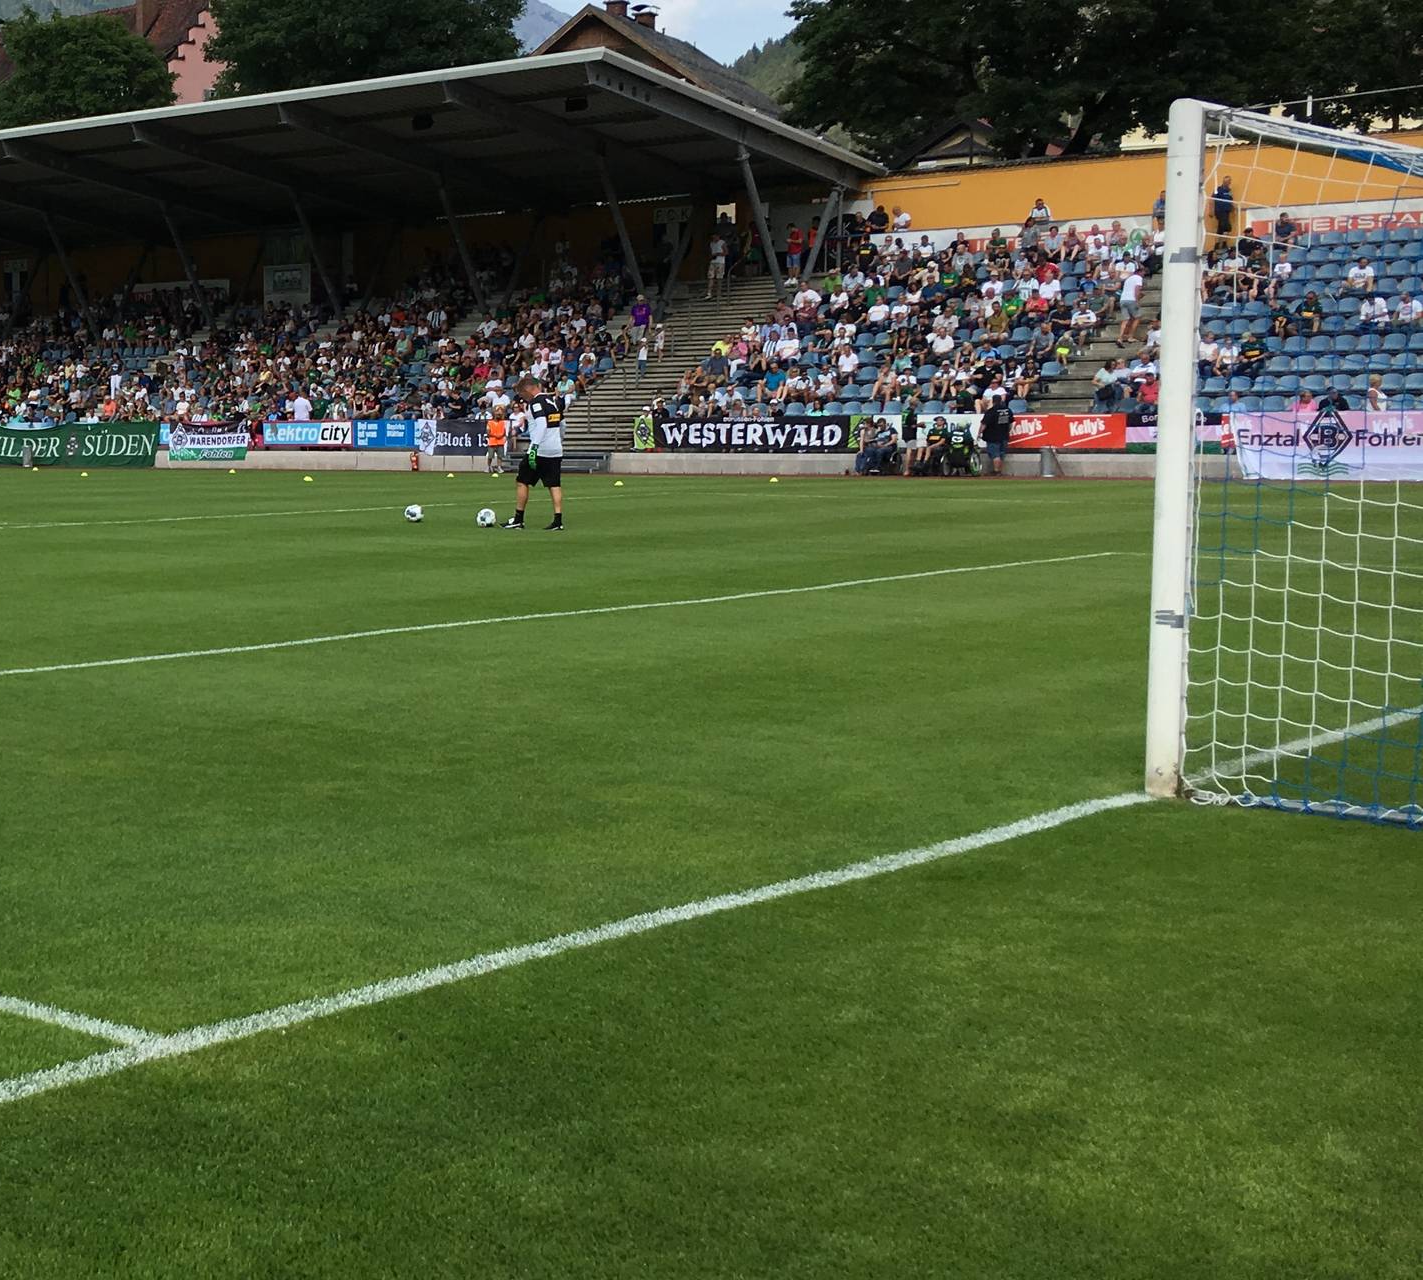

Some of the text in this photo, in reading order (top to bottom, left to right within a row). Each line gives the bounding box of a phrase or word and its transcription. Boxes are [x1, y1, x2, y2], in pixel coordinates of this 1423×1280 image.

[1267, 213, 1423, 234] ITERSPA
[661, 422, 842, 449] WESTERWALD
[1068, 418, 1106, 436] Kelly's
[82, 429, 156, 457] SÜDEN
[189, 435, 246, 446] WARENDORFER
[435, 432, 472, 448] Block
[1237, 428, 1300, 446] Enztal
